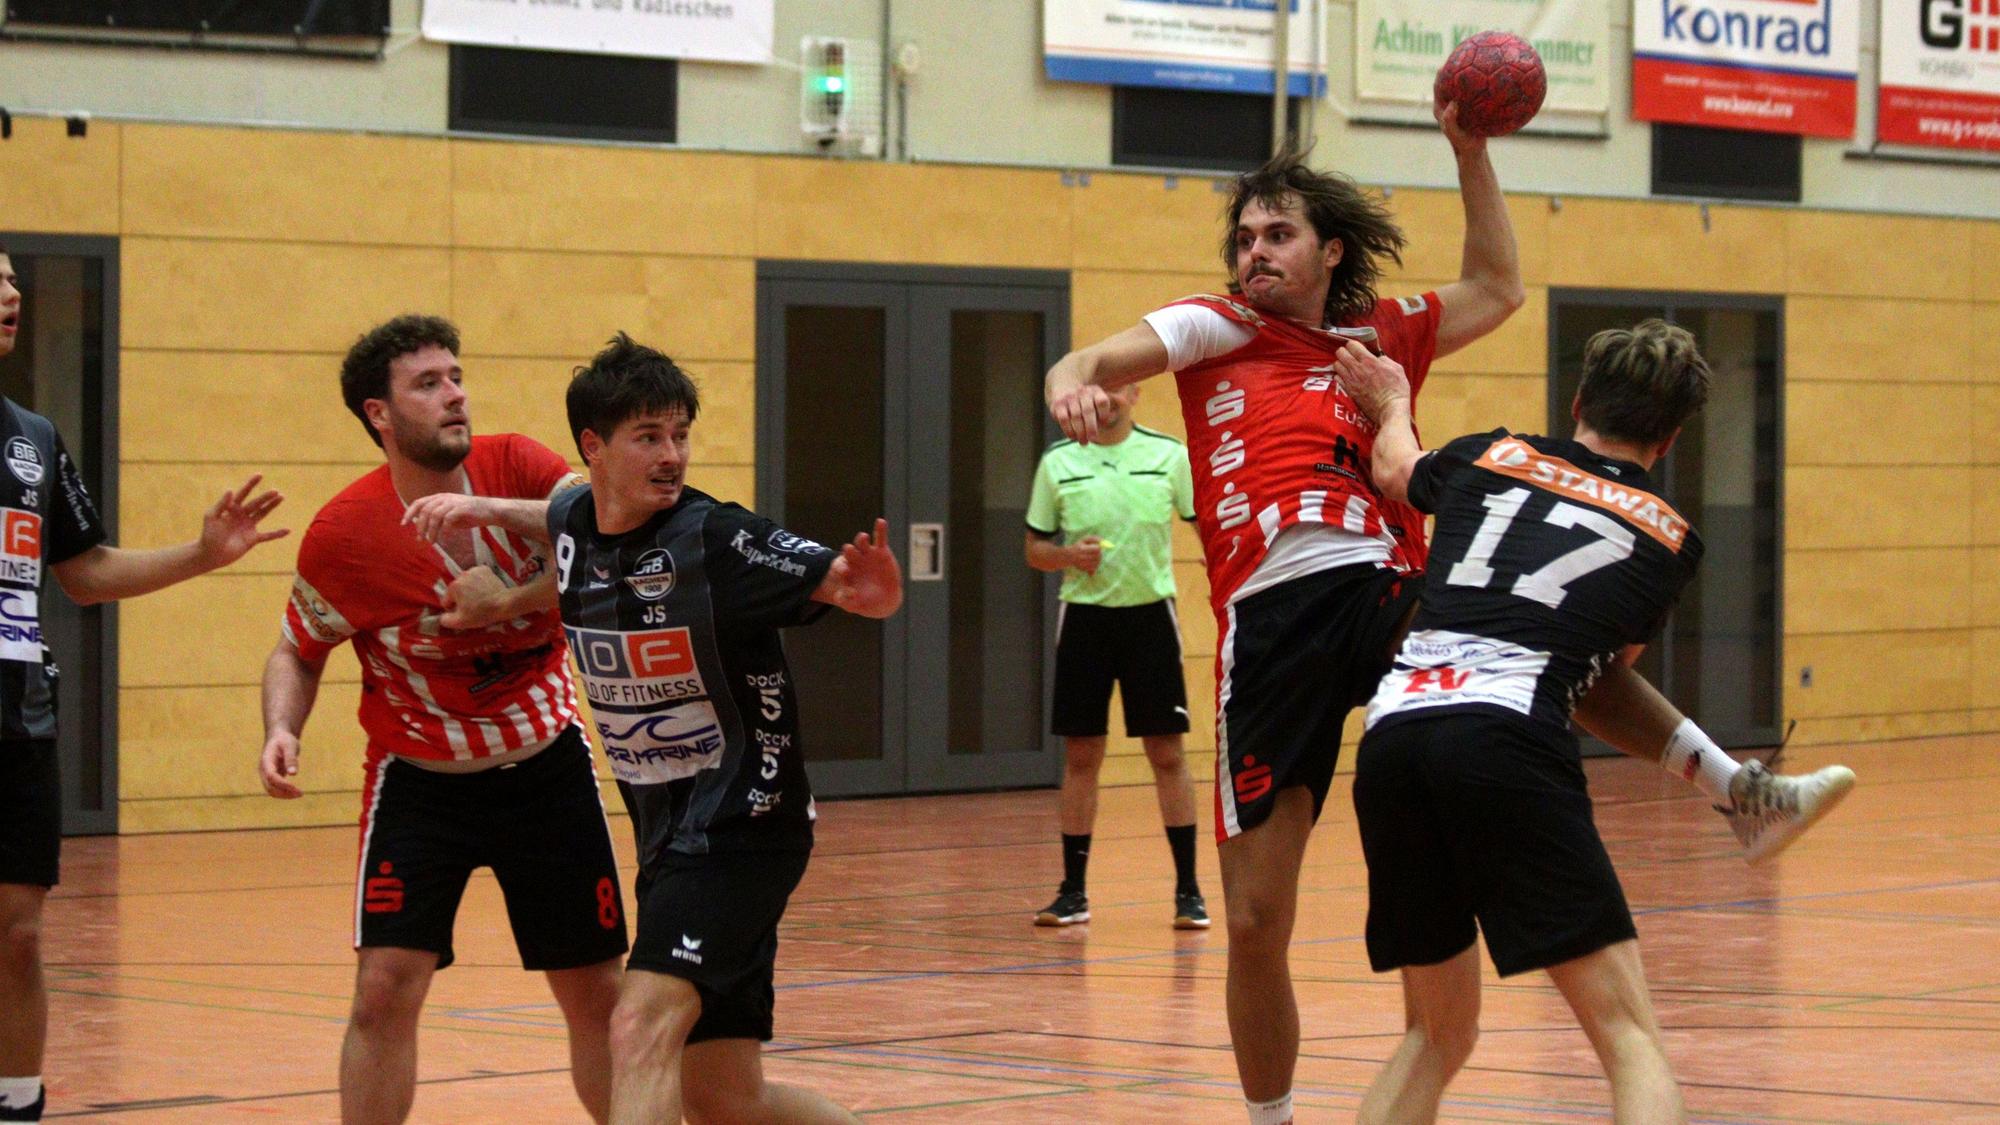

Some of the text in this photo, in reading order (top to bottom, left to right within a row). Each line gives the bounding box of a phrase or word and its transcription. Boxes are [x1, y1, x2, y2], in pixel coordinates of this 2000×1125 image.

[1373, 18, 1443, 55] Achim
[1662, 0, 1832, 56] konrad
[12, 441, 39, 463] BTB
[21, 488, 39, 507] JS
[1529, 459, 1684, 542] STAWAG
[1446, 487, 1637, 610] 17
[642, 604, 668, 625] JS
[601, 683, 618, 702] OF
[621, 678, 701, 704] FITNESS
[746, 671, 786, 687] DOCK
[760, 687, 782, 722] 5
[760, 746, 780, 781] 5
[595, 876, 619, 930] 8
